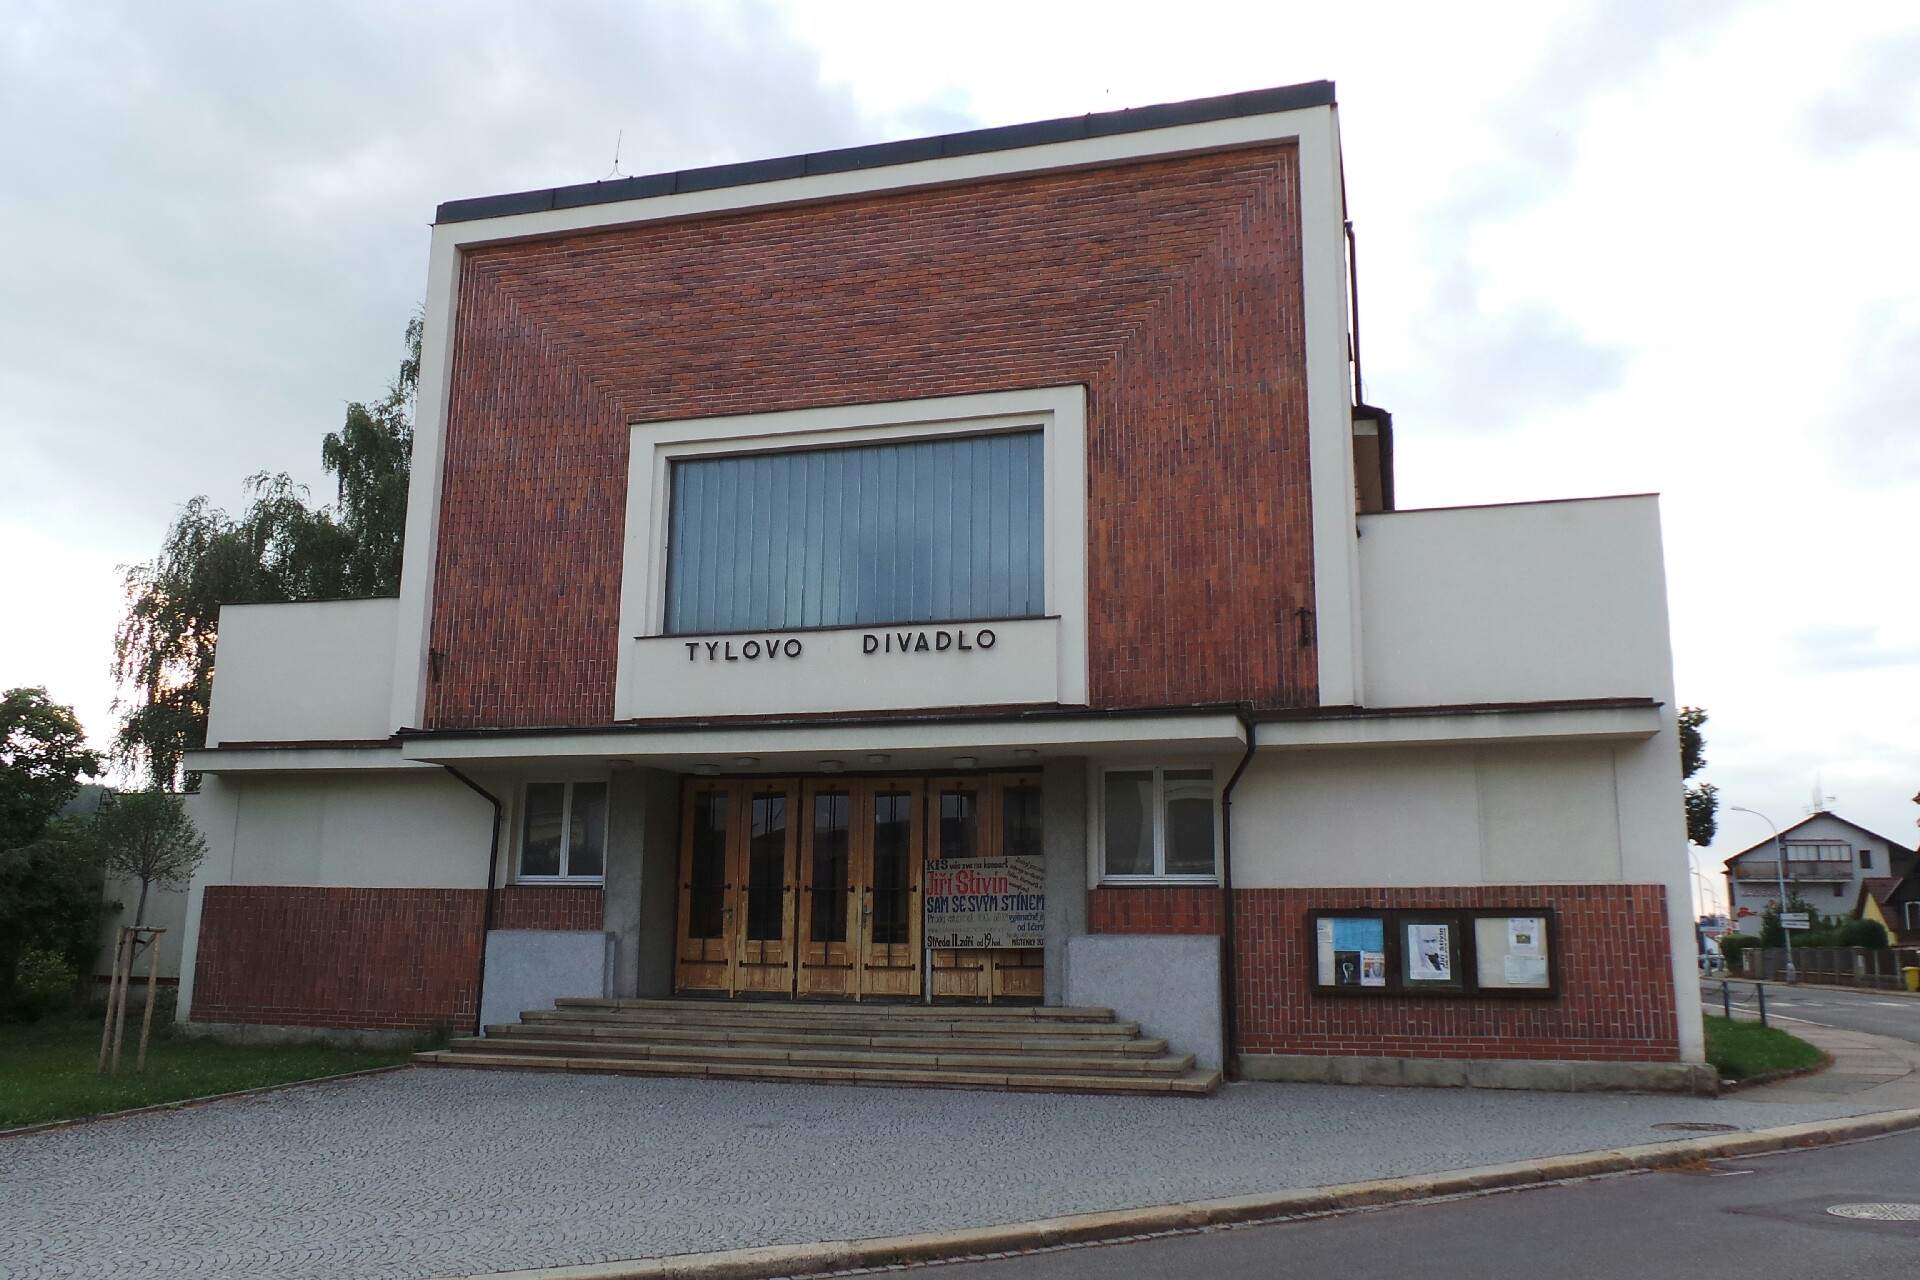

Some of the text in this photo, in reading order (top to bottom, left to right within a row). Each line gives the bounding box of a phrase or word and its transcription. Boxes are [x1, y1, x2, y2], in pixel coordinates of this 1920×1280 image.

[685, 629, 996, 661] TYLOVO DIVADLO
[983, 858, 1008, 869] koncert
[926, 871, 953, 896] Jiří
[955, 870, 1008, 895] Stivín
[952, 895, 966, 913] SE
[968, 892, 998, 912] SVÝM
[1001, 891, 1044, 911] STÍNEM
[1017, 922, 1026, 931] od
[927, 935, 951, 947] Středa
[977, 939, 984, 947] od
[984, 933, 992, 948] 19
[992, 938, 1003, 947] hod.
